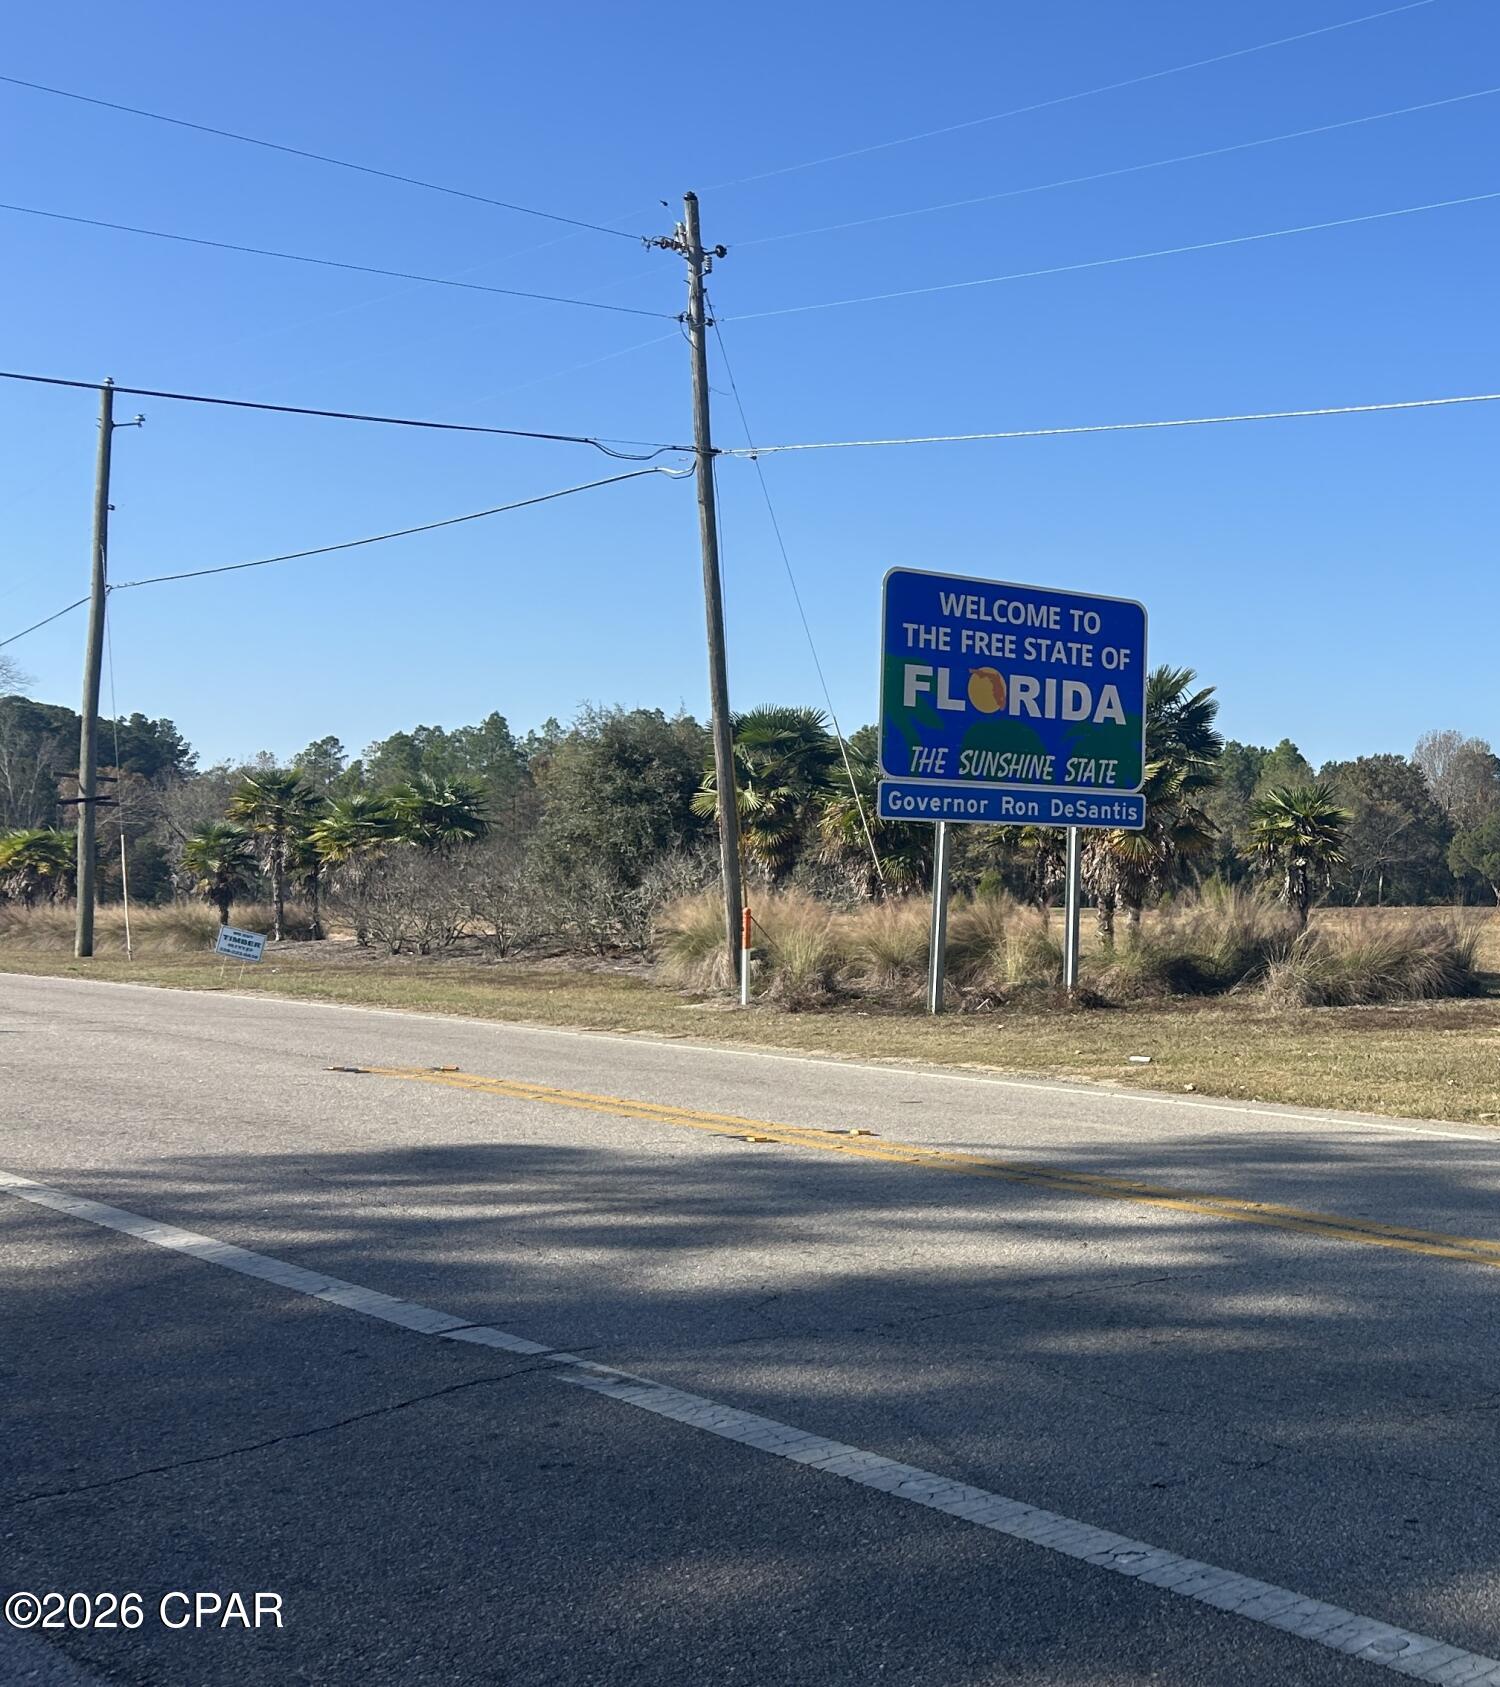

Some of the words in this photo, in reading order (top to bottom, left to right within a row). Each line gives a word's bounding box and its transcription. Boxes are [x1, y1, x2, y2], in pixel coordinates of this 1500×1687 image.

[939, 592, 1061, 629] WELCOME
[1070, 609, 1101, 634] TO
[903, 623, 951, 651] THE
[961, 629, 1016, 658] FREE
[1024, 637, 1093, 666] STATE
[1101, 647, 1131, 670] OF
[903, 664, 1126, 725] FLORIDA
[910, 746, 948, 774] THE
[959, 749, 1055, 781] SUNSHINE
[1065, 758, 1119, 784] STATE
[889, 792, 989, 814] Governor
[1001, 796, 1039, 817] Ron
[1051, 799, 1137, 821] DeSantis
[223, 934, 261, 948] TIMBER
